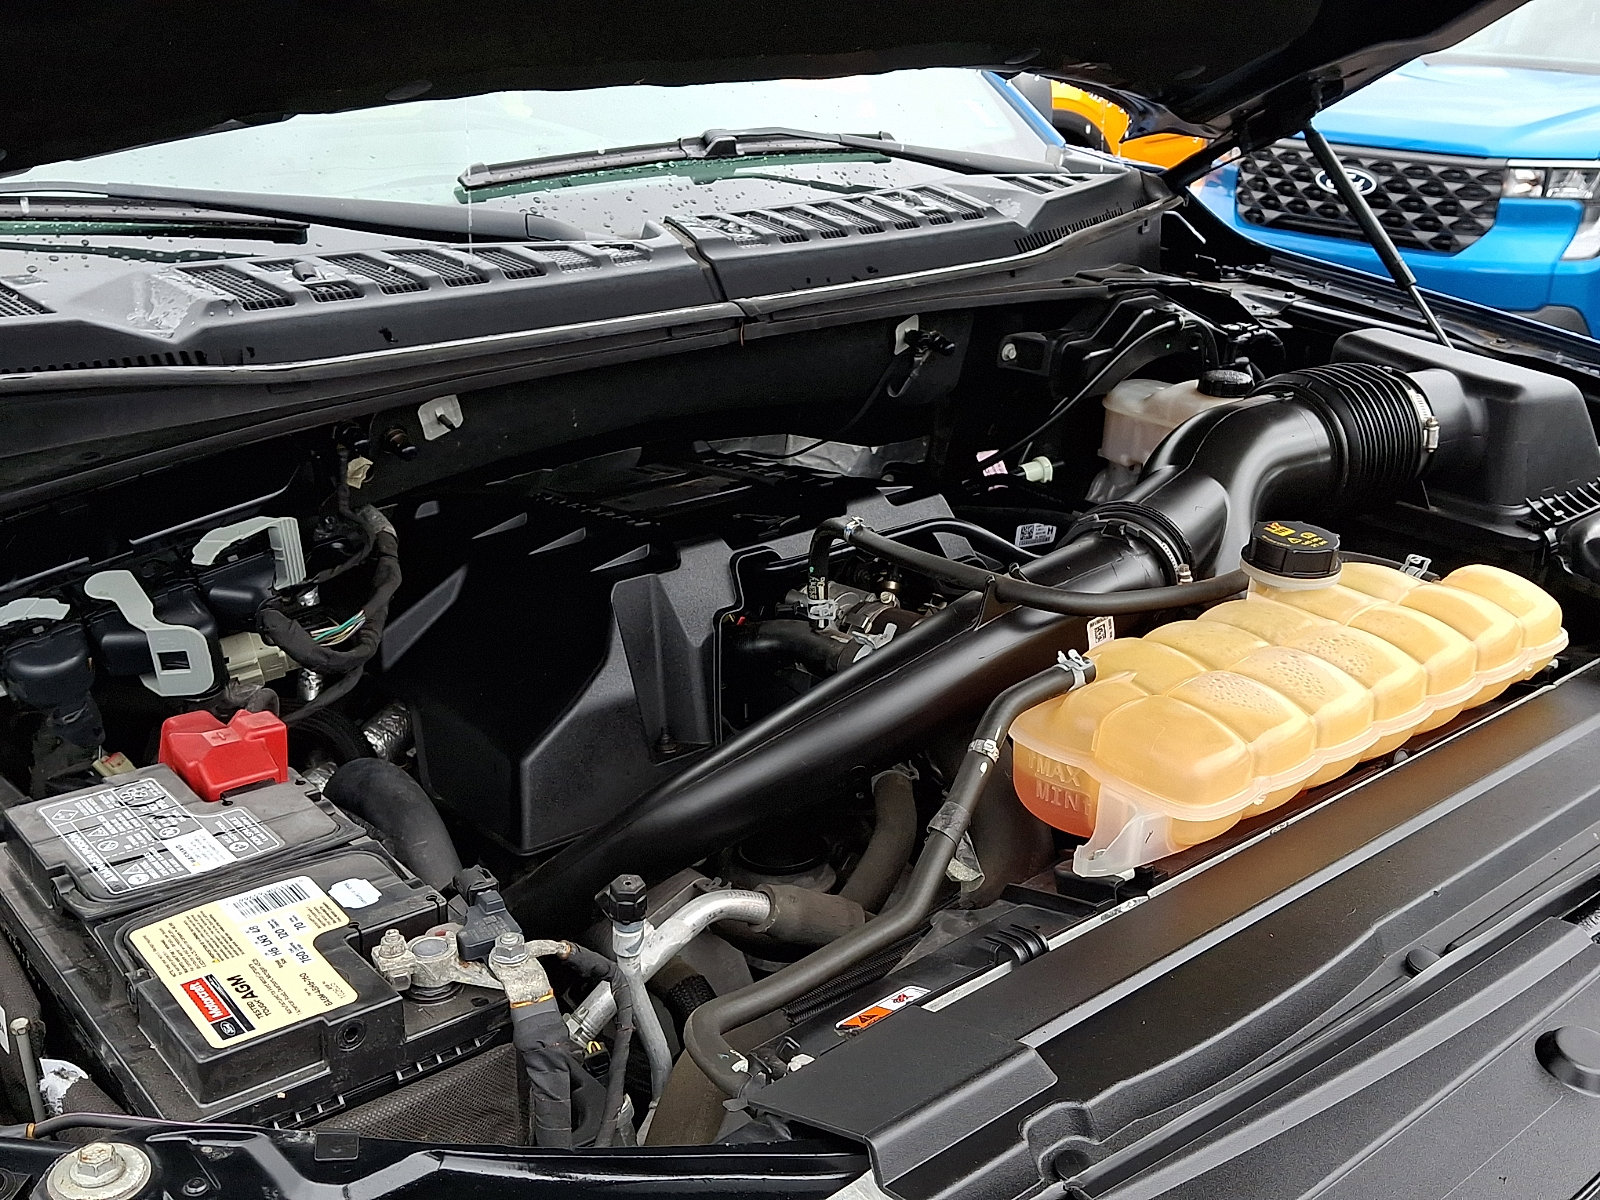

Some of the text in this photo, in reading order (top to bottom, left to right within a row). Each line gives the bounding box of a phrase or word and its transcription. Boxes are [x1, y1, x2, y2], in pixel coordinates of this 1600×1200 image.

[1036, 757, 1080, 787] MAX
[1036, 779, 1079, 812] MIN
[274, 927, 289, 939] 120
[293, 920, 306, 931] 70
[256, 933, 272, 947] LN3
[267, 946, 282, 957] H6
[295, 950, 312, 963] 760
[226, 973, 258, 1001] AGM
[187, 980, 224, 1018] Motorcraft
[245, 1000, 264, 1019] TESTED
